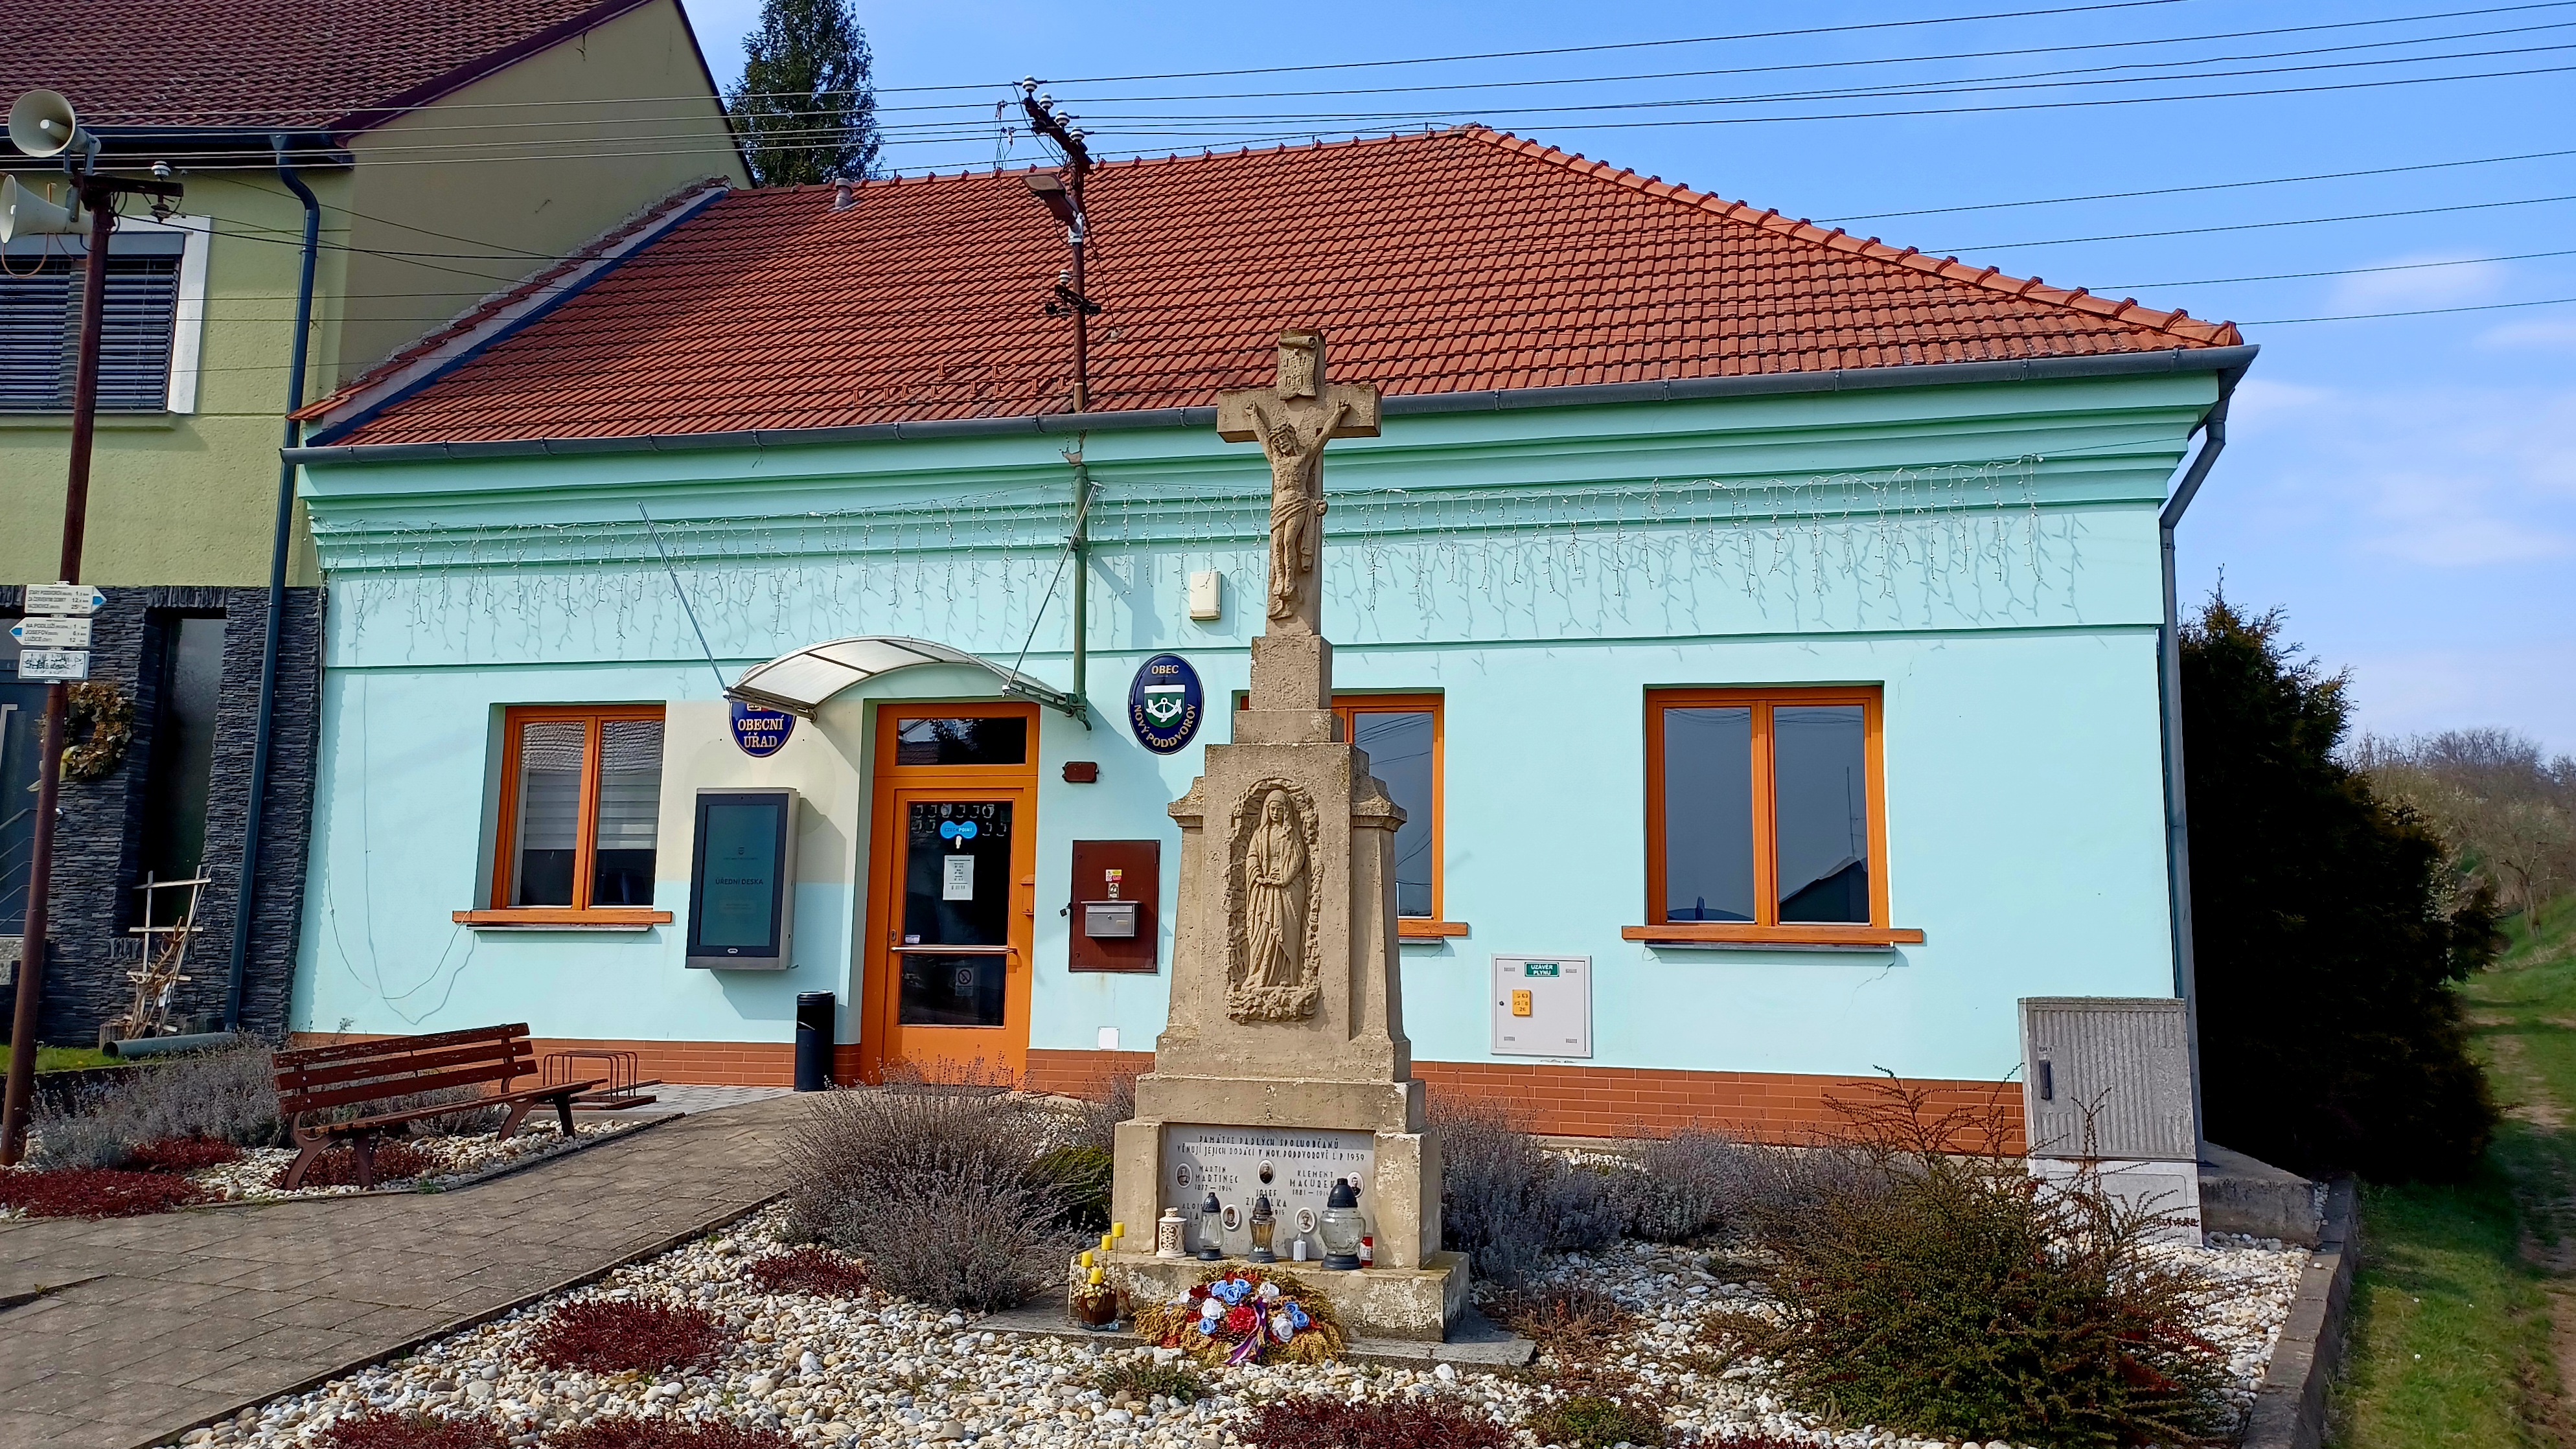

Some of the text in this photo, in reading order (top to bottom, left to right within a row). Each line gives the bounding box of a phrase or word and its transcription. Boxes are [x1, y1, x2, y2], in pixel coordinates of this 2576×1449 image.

[1151, 665, 1179, 674] OBEC
[737, 714, 785, 731] OBECNÍ
[1134, 703, 1196, 747] NOVÝ PODDVOROV
[744, 732, 777, 748] ÚŘAD
[1199, 1134, 1339, 1149] PAMÁTCE PADLÝCH SPOLUOBČANŮ
[1177, 1143, 1201, 1155] VĚNUJÍ
[1204, 1146, 1226, 1156] JEJICH
[1230, 1147, 1254, 1156] RODÁCI
[1283, 1150, 1329, 1159] PODDVOROVĚ
[1195, 1174, 1238, 1183] MARTINEC
[1256, 1189, 1277, 1197] JOSEF
